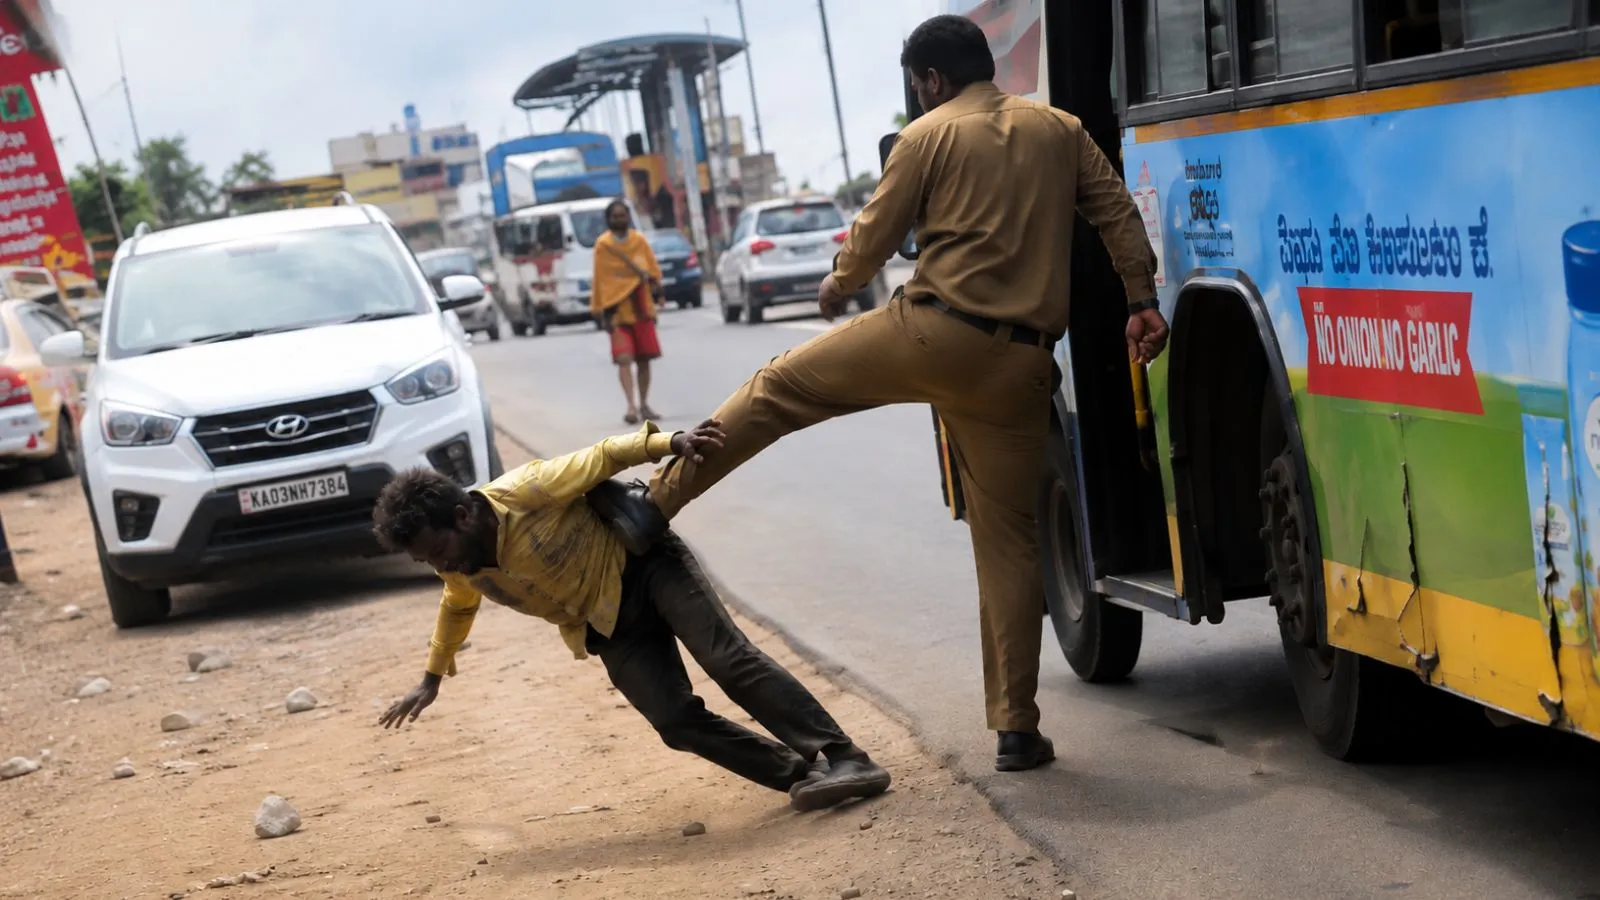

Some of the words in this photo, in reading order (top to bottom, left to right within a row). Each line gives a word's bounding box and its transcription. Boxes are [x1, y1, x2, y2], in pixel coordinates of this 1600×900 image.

[1313, 314, 1336, 366] NO
[1336, 315, 1382, 370] ONION
[1381, 318, 1404, 372] NO
[1406, 320, 1461, 377] GARLIC
